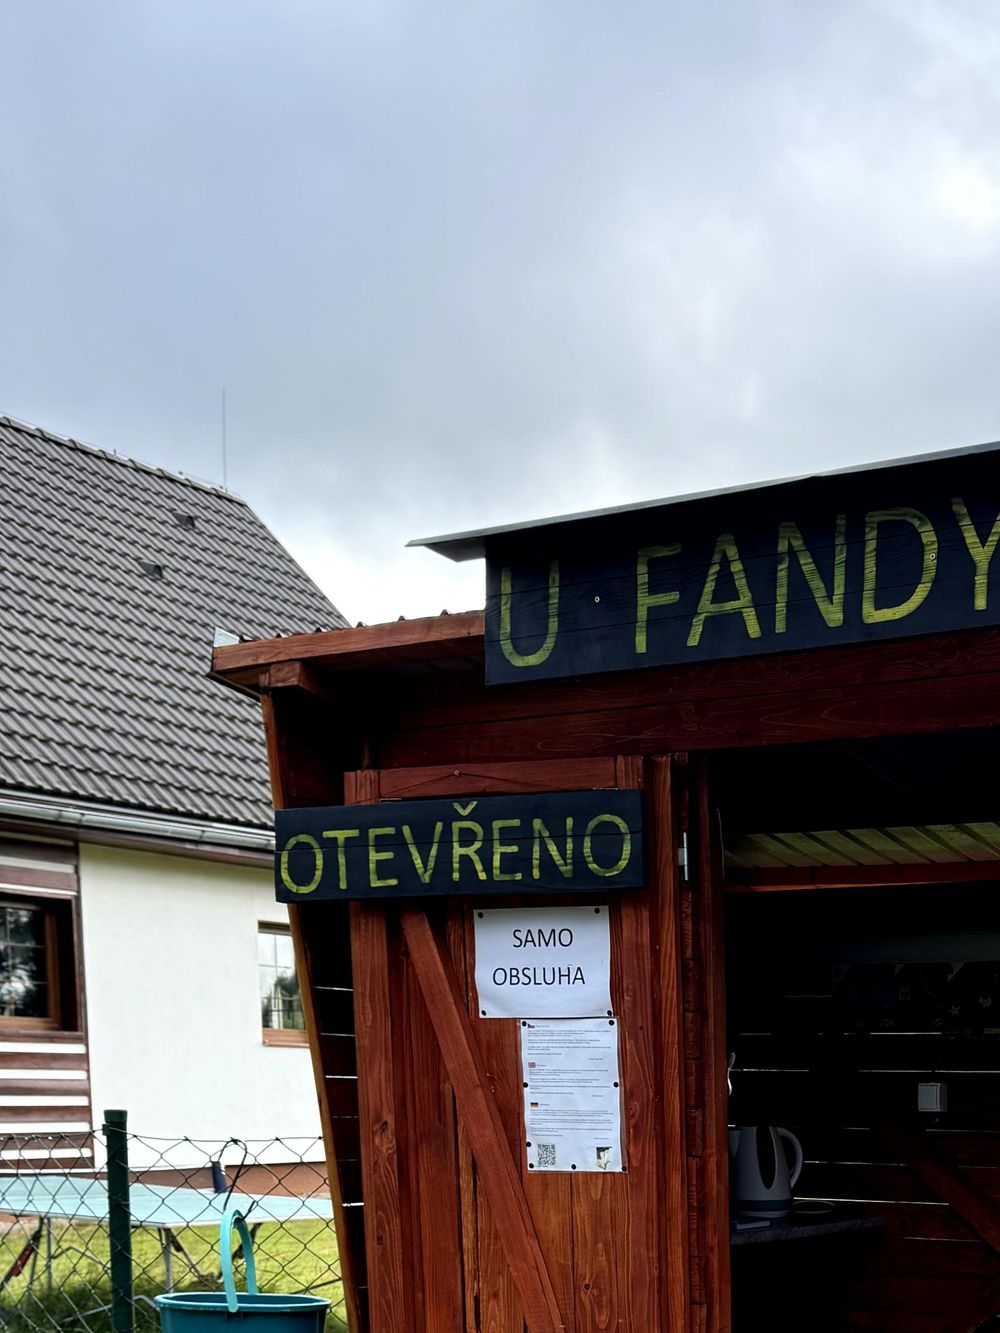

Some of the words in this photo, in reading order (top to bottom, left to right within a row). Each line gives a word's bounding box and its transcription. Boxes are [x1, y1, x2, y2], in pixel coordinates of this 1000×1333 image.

[500, 559, 559, 667] U
[280, 801, 632, 894] OTEVŘENO
[512, 928, 574, 948] SAMO
[492, 966, 586, 986] OBSLUHA
